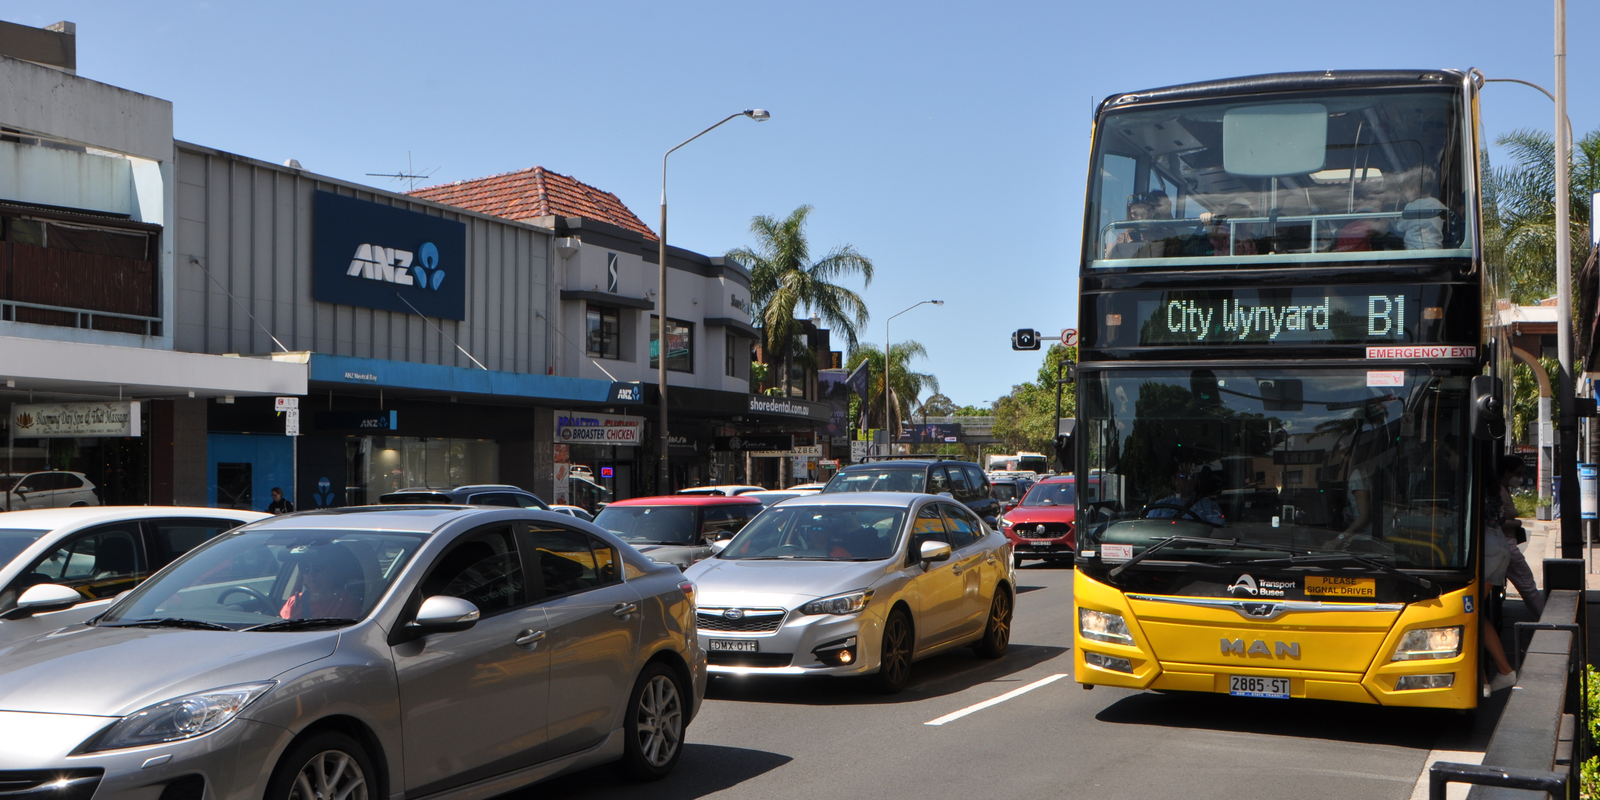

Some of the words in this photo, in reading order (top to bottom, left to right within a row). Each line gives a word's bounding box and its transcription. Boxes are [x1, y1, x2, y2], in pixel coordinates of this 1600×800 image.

[346, 243, 413, 286] ANZ
[1167, 299, 1213, 340] City
[1223, 297, 1330, 340] Wynyard
[1368, 295, 1405, 336] B1
[1368, 347, 1448, 358] EMERGENCY
[1451, 347, 1475, 357] EXIT
[354, 372, 369, 380] Neutral
[369, 374, 377, 382] Bay
[617, 388, 633, 400] ANZ
[750, 397, 810, 416] shoredental.com.au
[36, 410, 61, 429] Blooming
[61, 411, 73, 429] Day
[73, 410, 84, 429] Spa
[92, 407, 104, 424] Thai
[105, 410, 129, 428] Massage
[360, 419, 378, 428] ANZ
[572, 429, 605, 440] BROASTER
[606, 429, 635, 440] CHICKEN
[1258, 579, 1296, 589] Transport
[1322, 577, 1357, 585] PLEASE
[1259, 588, 1285, 597] Buses
[1306, 585, 1337, 594] SIGNAL
[1340, 587, 1373, 595] DRIVER
[1220, 638, 1299, 656] MAN
